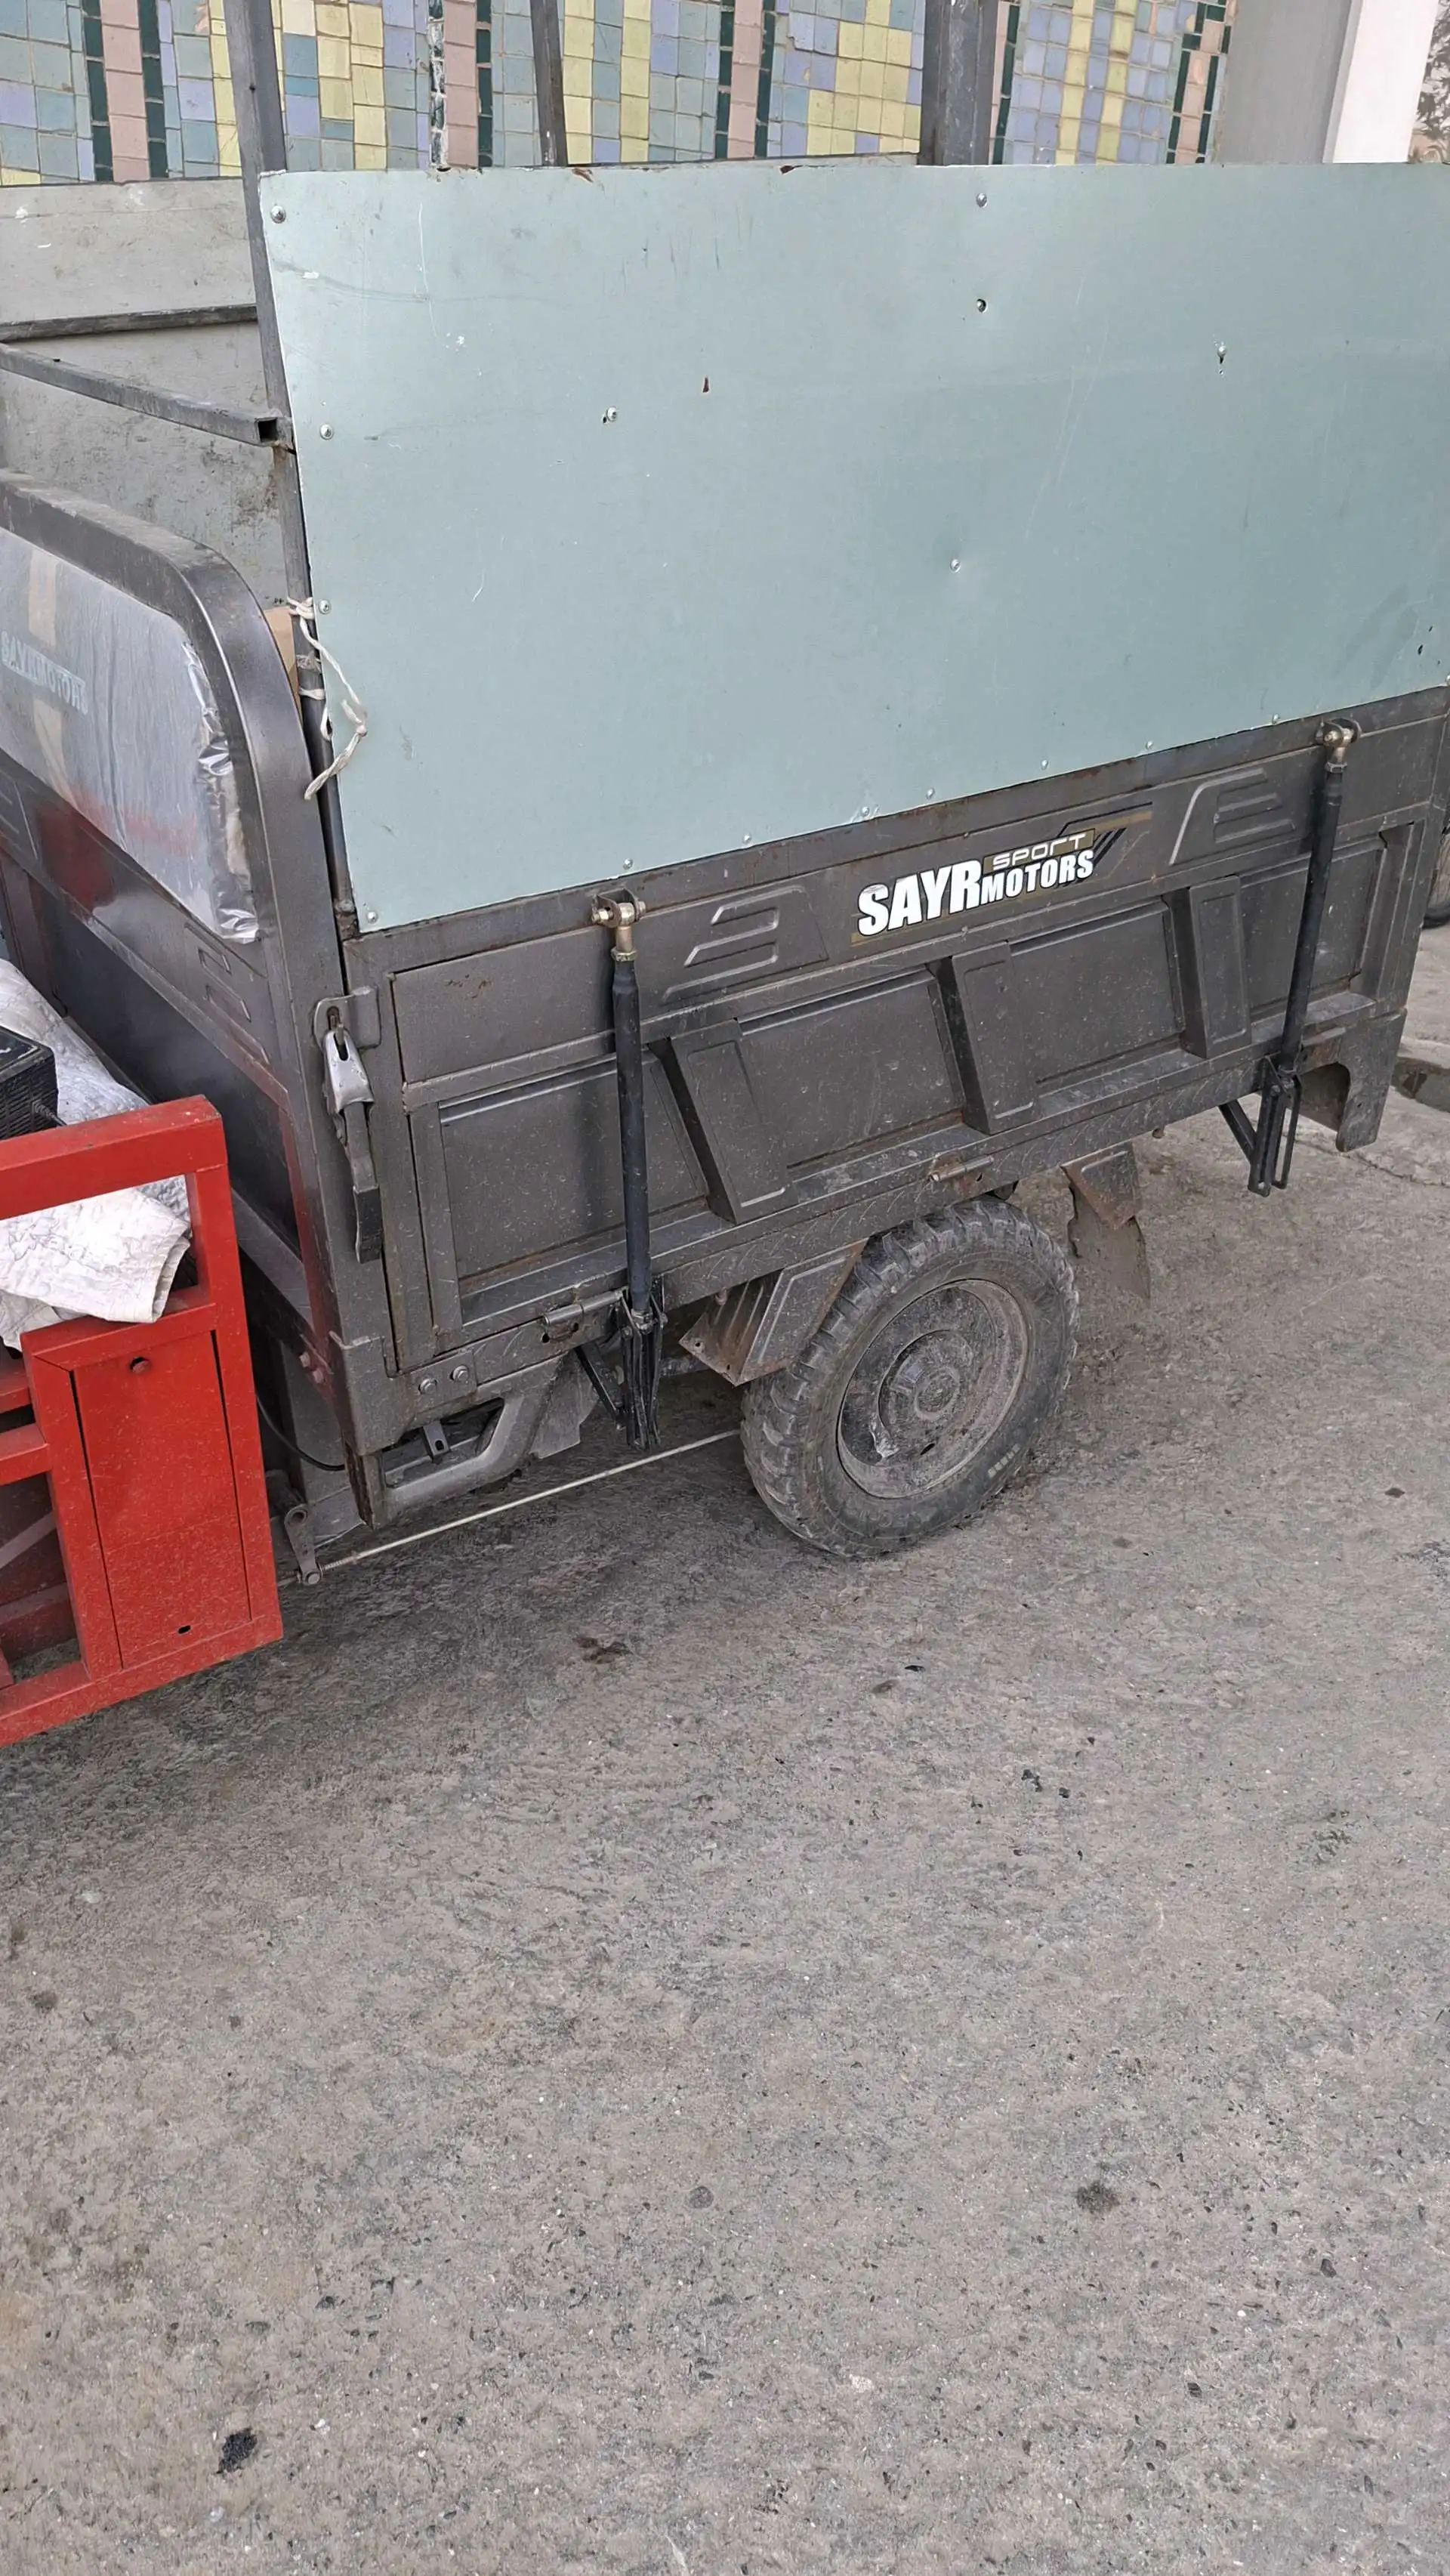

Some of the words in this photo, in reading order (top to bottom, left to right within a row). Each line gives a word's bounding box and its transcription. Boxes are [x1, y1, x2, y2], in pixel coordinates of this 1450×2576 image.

[992, 833, 1086, 869] SPORT
[858, 860, 982, 936] SAYR
[981, 850, 1094, 904] MOTORS
